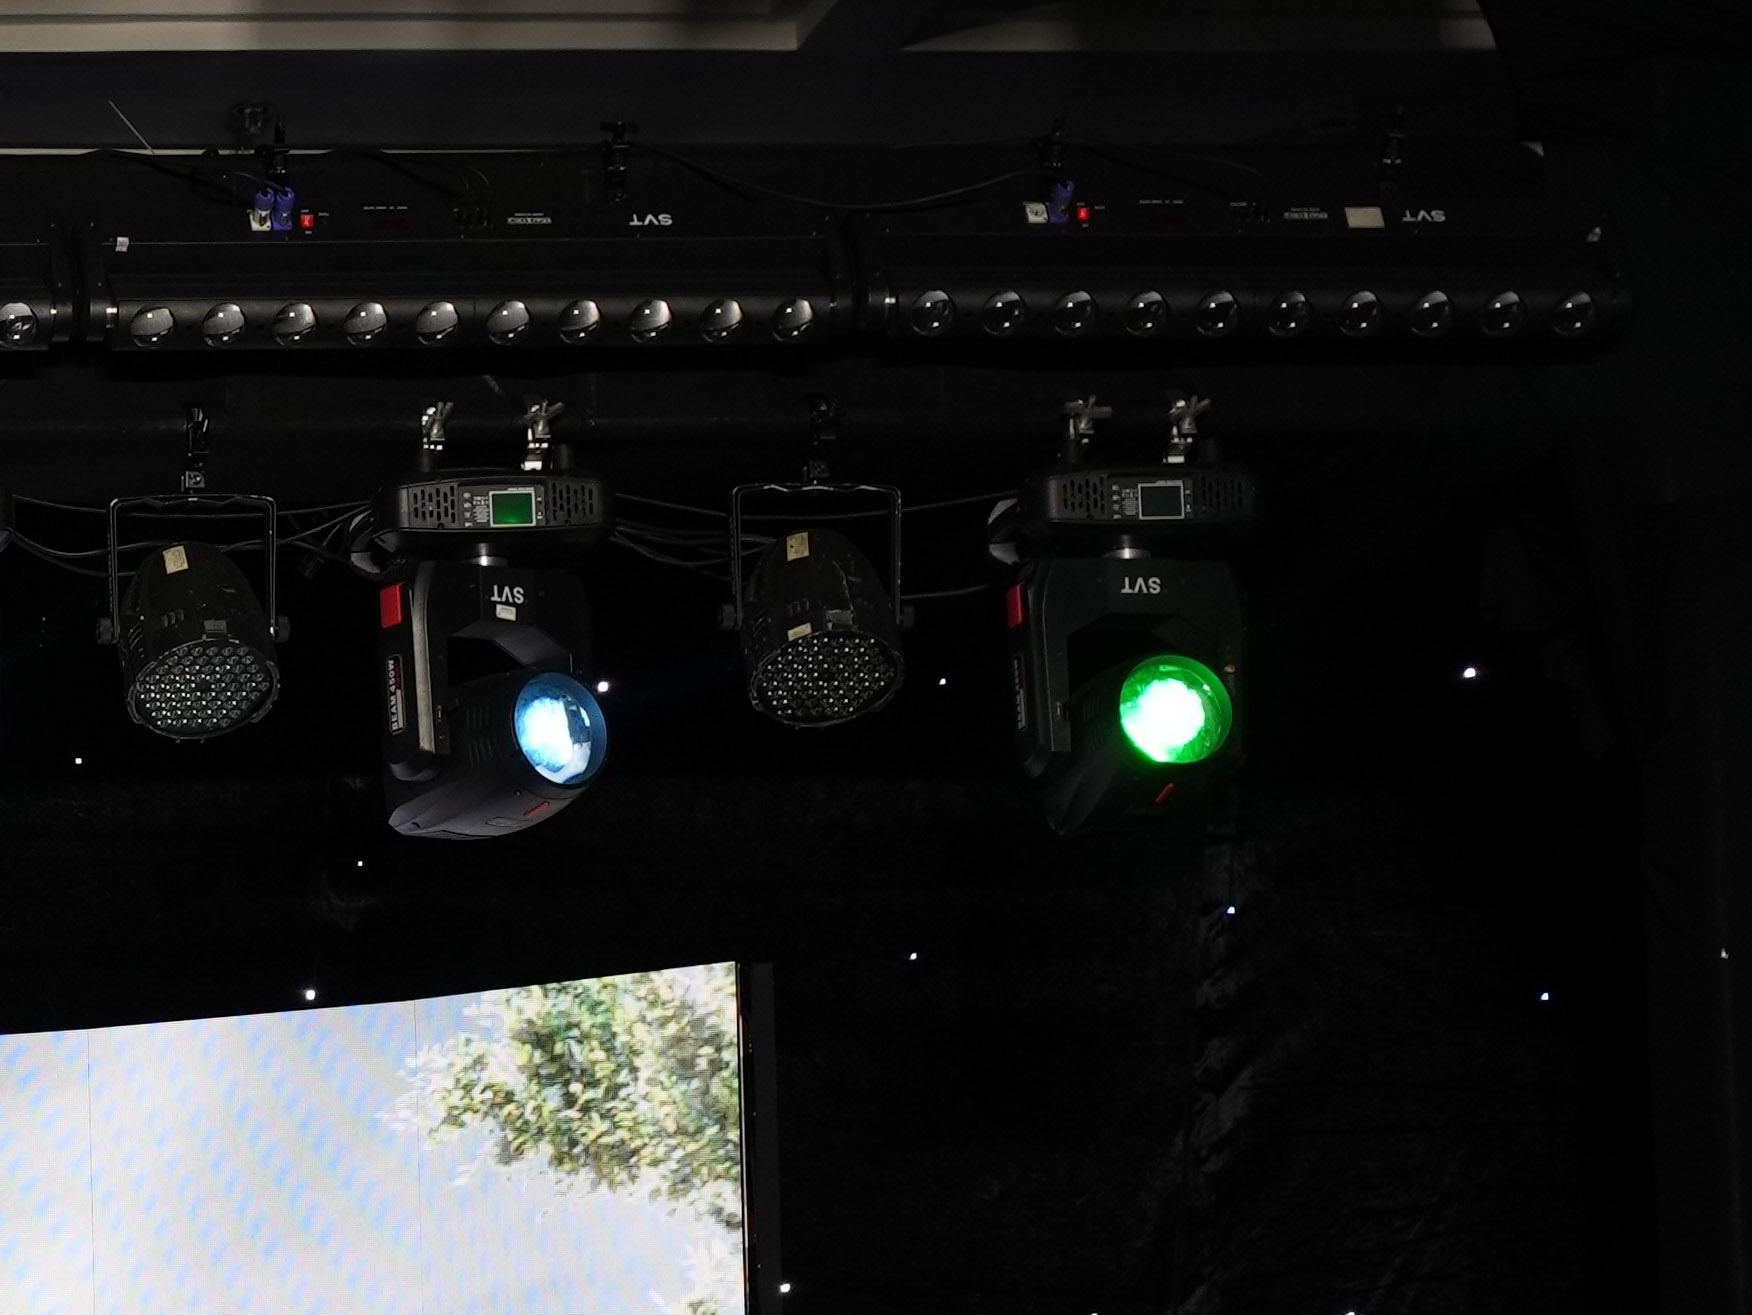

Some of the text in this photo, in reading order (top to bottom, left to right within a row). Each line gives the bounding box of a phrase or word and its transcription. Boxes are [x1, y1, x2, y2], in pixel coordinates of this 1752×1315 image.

[630, 214, 672, 225] SVT
[1403, 210, 1445, 222] SVT
[1121, 577, 1160, 594] SVT
[491, 585, 524, 604] SVT
[388, 660, 398, 731] BEAM 450W
